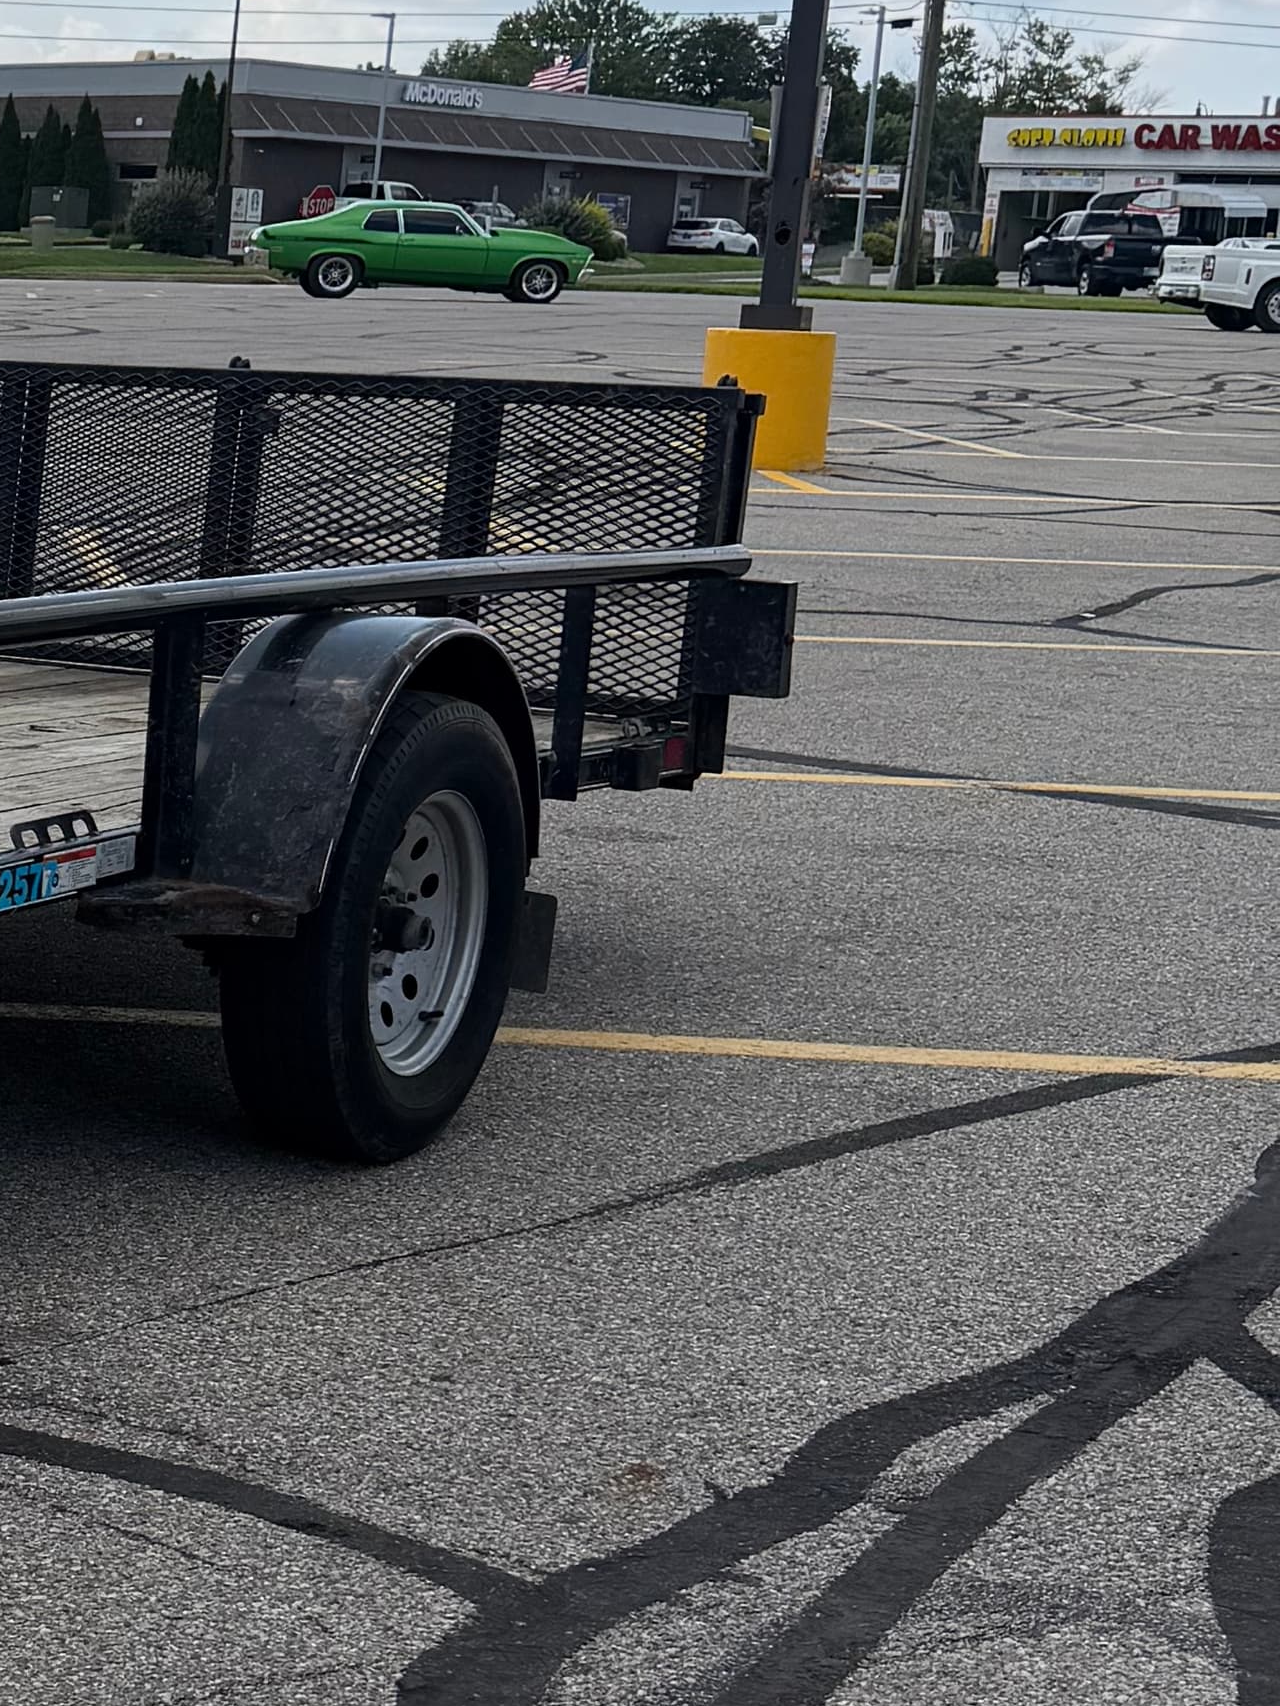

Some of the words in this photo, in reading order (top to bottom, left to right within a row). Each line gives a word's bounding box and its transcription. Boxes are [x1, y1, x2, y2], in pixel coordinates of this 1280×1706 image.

[404, 81, 483, 109] McDonald's
[1007, 127, 1056, 148] SOFT
[1134, 123, 1202, 151] CAR
[308, 197, 334, 214] STOP
